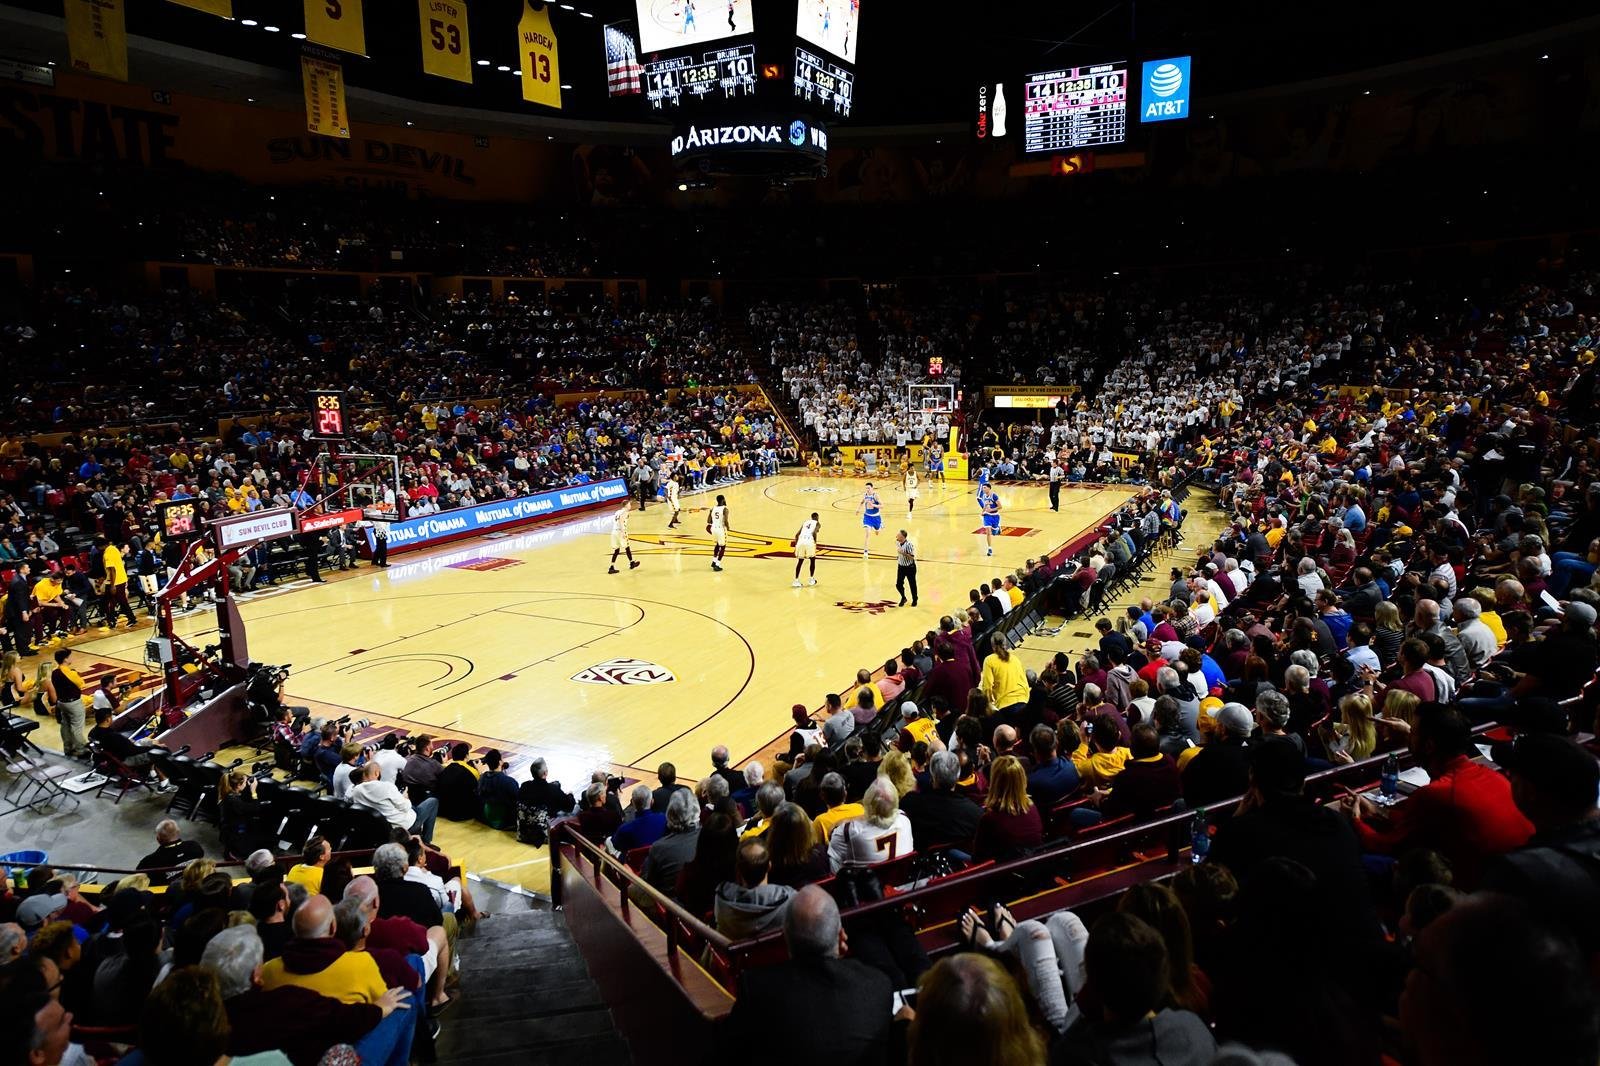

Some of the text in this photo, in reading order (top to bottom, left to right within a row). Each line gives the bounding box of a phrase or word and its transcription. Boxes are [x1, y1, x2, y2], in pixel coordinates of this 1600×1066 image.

[429, 2, 458, 18] LISTER
[430, 18, 461, 54] 53
[523, 32, 553, 51] HARDEN
[529, 52, 550, 82] 13
[682, 66, 717, 84] 12:35
[728, 58, 748, 76] 10
[800, 62, 811, 80] 14
[654, 72, 673, 91] 14
[838, 81, 850, 98] 10
[1032, 84, 1051, 97] 14
[1058, 79, 1092, 93] 12:35
[1100, 74, 1119, 89] 10
[979, 86, 987, 112] zero
[1146, 100, 1184, 118] AT&T
[686, 125, 782, 149] ARIZONA
[930, 363, 942, 374] 29
[318, 396, 340, 410] 12:35
[320, 410, 340, 432] 29
[560, 484, 625, 506] MUTUAL of OMAHA
[166, 504, 195, 518] 12:35
[474, 499, 554, 524] MUTUAL of OMAHA
[238, 520, 288, 536] SUN DEVIL CLUB
[418, 520, 430, 538] of
[430, 517, 467, 534] OMAHA
[876, 832, 897, 861] 7
